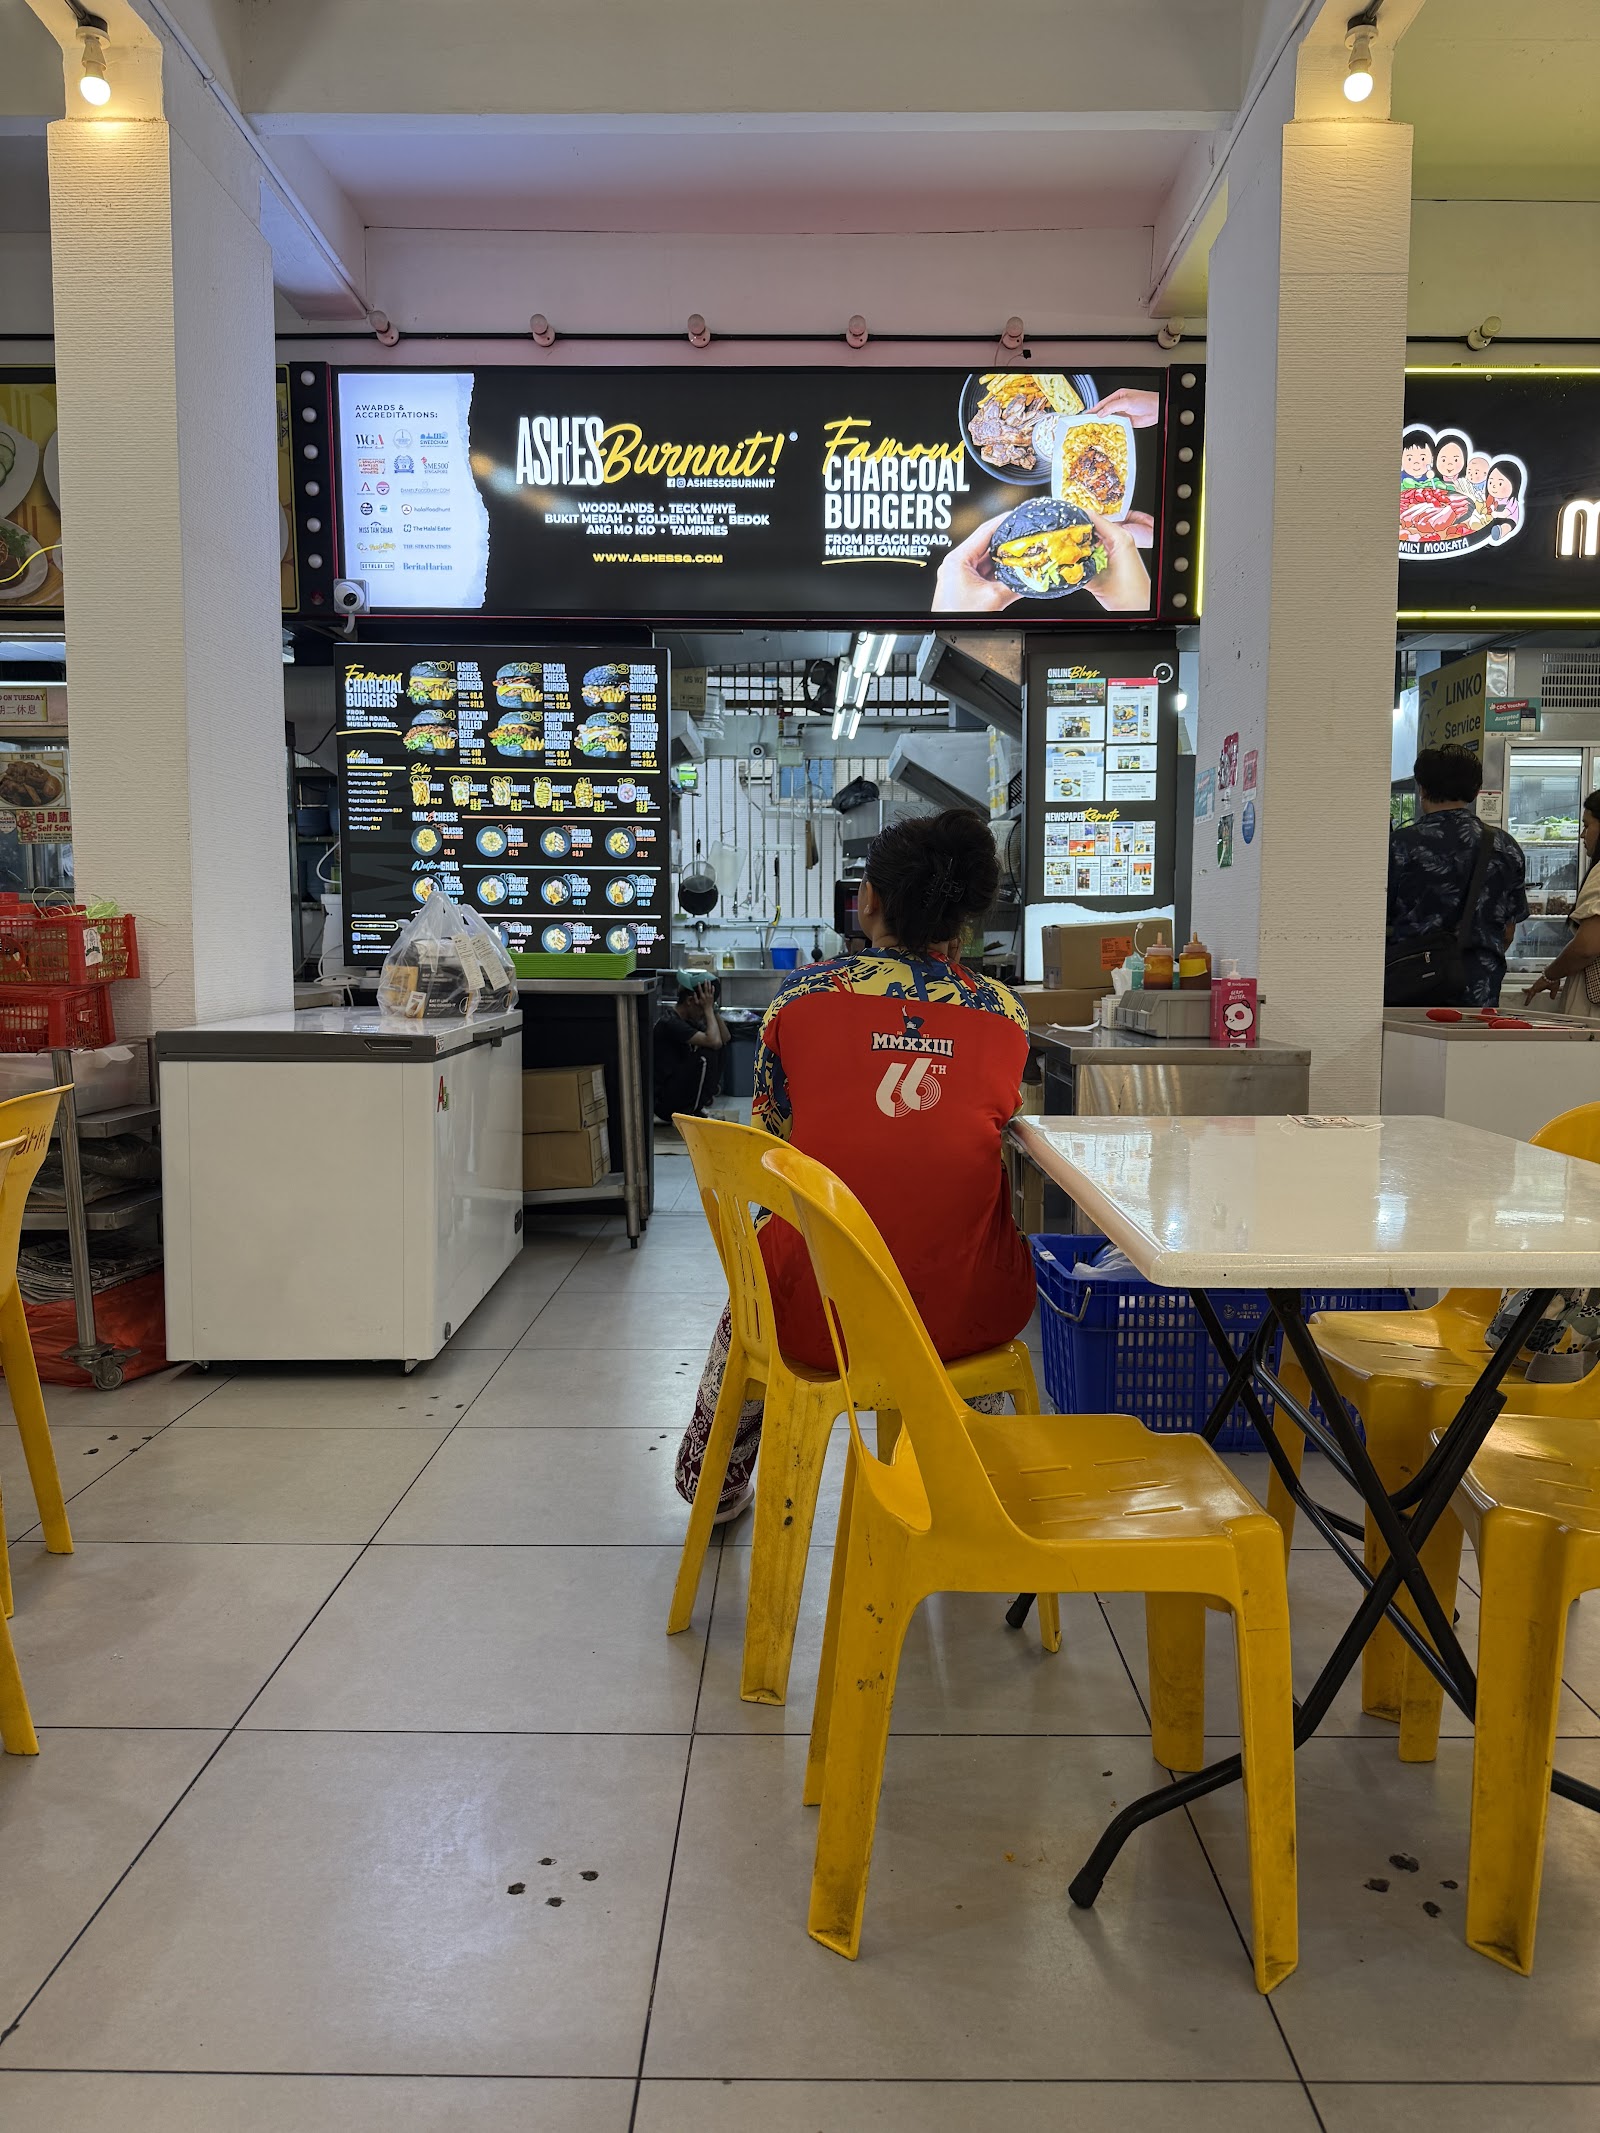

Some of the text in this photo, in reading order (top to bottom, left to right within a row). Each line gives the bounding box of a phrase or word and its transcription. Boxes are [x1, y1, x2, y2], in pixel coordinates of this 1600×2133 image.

[822, 415, 967, 475] Famous
[515, 415, 784, 487] ASHES Burnnit!
[824, 455, 970, 492] CHARCOAL
[686, 478, 776, 489] @ASHESSGBURNNIT
[577, 502, 737, 514] WOODLANDS TECK WHYE
[824, 494, 952, 530] BURGERS
[545, 513, 770, 525] BUKIT MERAH GOLDEN MILE BEDOK
[586, 524, 728, 536] ANG MO KIO TAMPINES
[825, 534, 953, 548] FROM BEACH ROAD,
[1423, 537, 1469, 553] MOOKATA
[825, 545, 931, 557] MUSLIM OWNED.
[592, 553, 724, 564] WWW.ASHESSG.COM
[457, 662, 478, 671] ASHES
[543, 663, 566, 673] BACON
[630, 664, 656, 675] TRUFFLE
[345, 664, 403, 685] Famous
[457, 671, 481, 681] CHEESE
[1047, 665, 1100, 680] ONLINE Blogs
[543, 673, 567, 683] CHEESE
[345, 678, 404, 693] CHARCOAL
[458, 681, 484, 690] BURGER
[543, 683, 569, 692] BURGER
[630, 684, 655, 693] BURGER
[1446, 672, 1482, 707] LINKO
[13, 693, 45, 701] TUESDAY
[346, 693, 398, 708] BURGERS
[1507, 702, 1527, 710] Voucher
[458, 711, 488, 720] MEXICAN
[544, 712, 574, 722] CHIPOTLE
[630, 713, 655, 723] GRILLED
[1495, 713, 1520, 722] Accepted
[458, 720, 483, 730] PULLED
[544, 722, 562, 731] FRIED
[630, 723, 659, 732] TERIYAKI
[1445, 715, 1481, 740] Service
[459, 730, 475, 739] BEEF
[544, 731, 572, 740] CHICKEN
[630, 732, 658, 741] CHICKEN
[459, 739, 485, 748] BURGER
[544, 740, 570, 750] BURGER
[630, 741, 656, 751] BURGER
[430, 783, 444, 791] FRIES
[411, 812, 459, 822] MAC CHEESE
[1045, 812, 1086, 822] NEWSPAPER
[38, 824, 53, 832] Self
[440, 861, 459, 871] GRILL
[443, 883, 463, 891] PEPPER
[872, 1032, 955, 1057] MMXXIII
[876, 1058, 947, 1118] 66 TH
